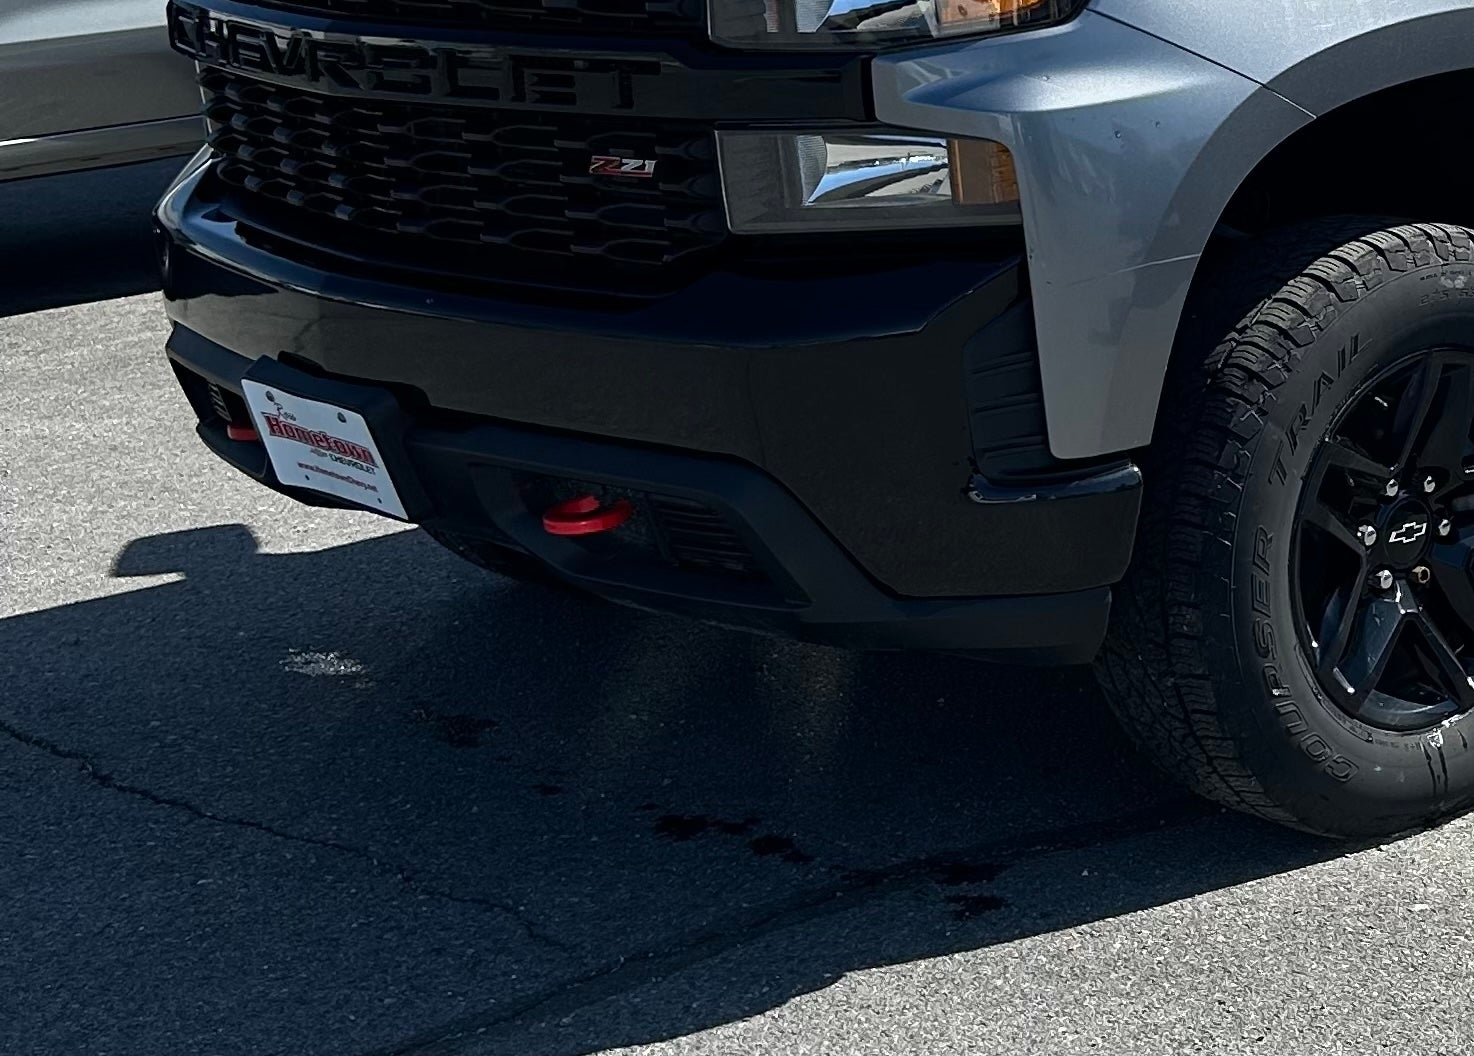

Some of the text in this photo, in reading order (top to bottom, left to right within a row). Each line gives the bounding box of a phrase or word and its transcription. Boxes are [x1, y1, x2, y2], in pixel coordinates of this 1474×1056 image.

[172, 4, 662, 110] CHEVROLET
[589, 155, 657, 178] Z71
[264, 414, 376, 466] Hometown
[1251, 333, 1373, 783] COURSER TRAIL
